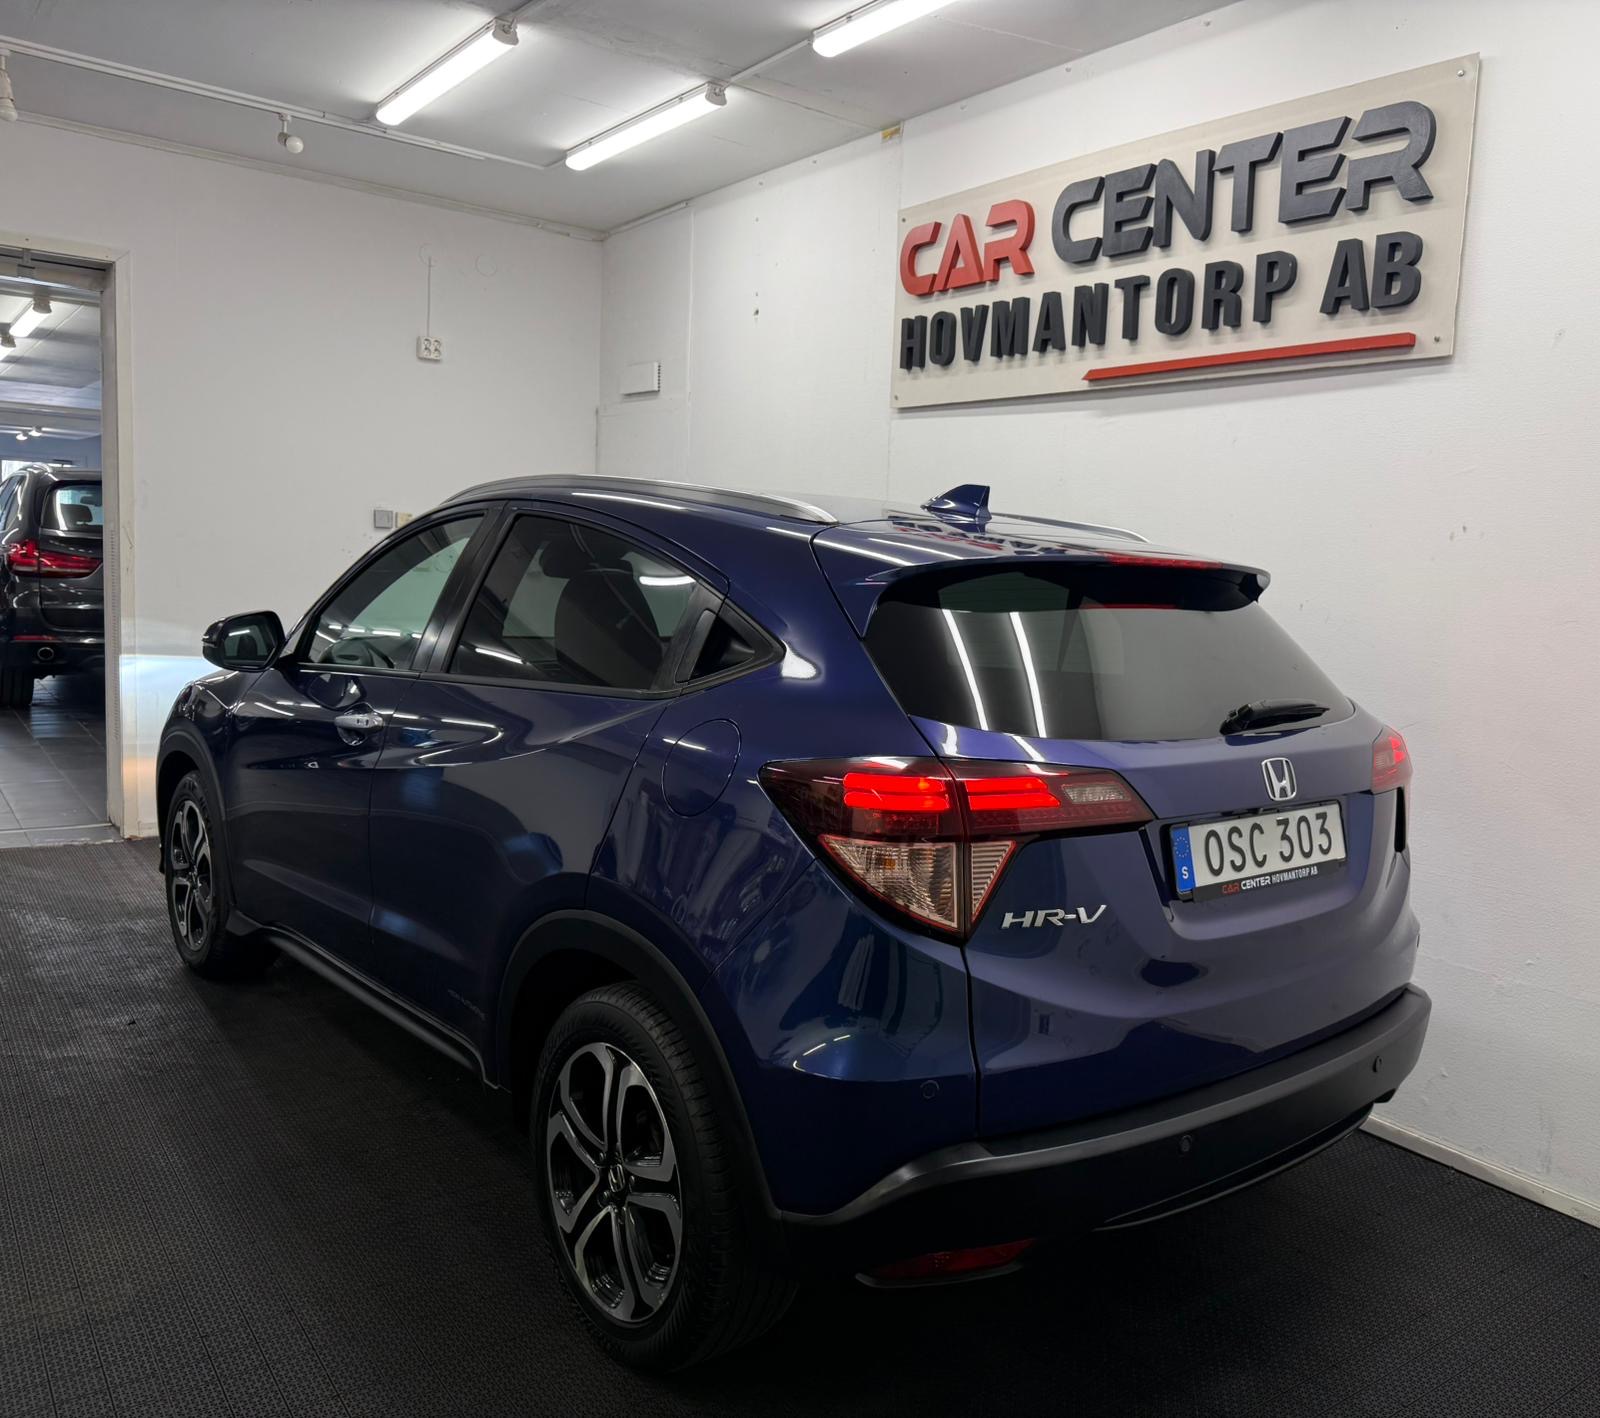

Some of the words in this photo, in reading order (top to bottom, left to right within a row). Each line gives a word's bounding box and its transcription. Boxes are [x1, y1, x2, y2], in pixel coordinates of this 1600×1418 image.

[900, 199, 1036, 297] CAR
[1051, 100, 1434, 264] CENTER
[900, 250, 1298, 370] HOVMANTORP
[1319, 231, 1423, 315] AB
[1204, 821, 1268, 877] OSC
[1275, 811, 1333, 863] 303
[1181, 865, 1189, 880] S
[1222, 882, 1240, 895] CAR
[1240, 875, 1271, 890] CENTER
[1271, 866, 1310, 885] HOVMANTORP
[1310, 865, 1318, 876] AB
[1001, 904, 1108, 929] HR-V
